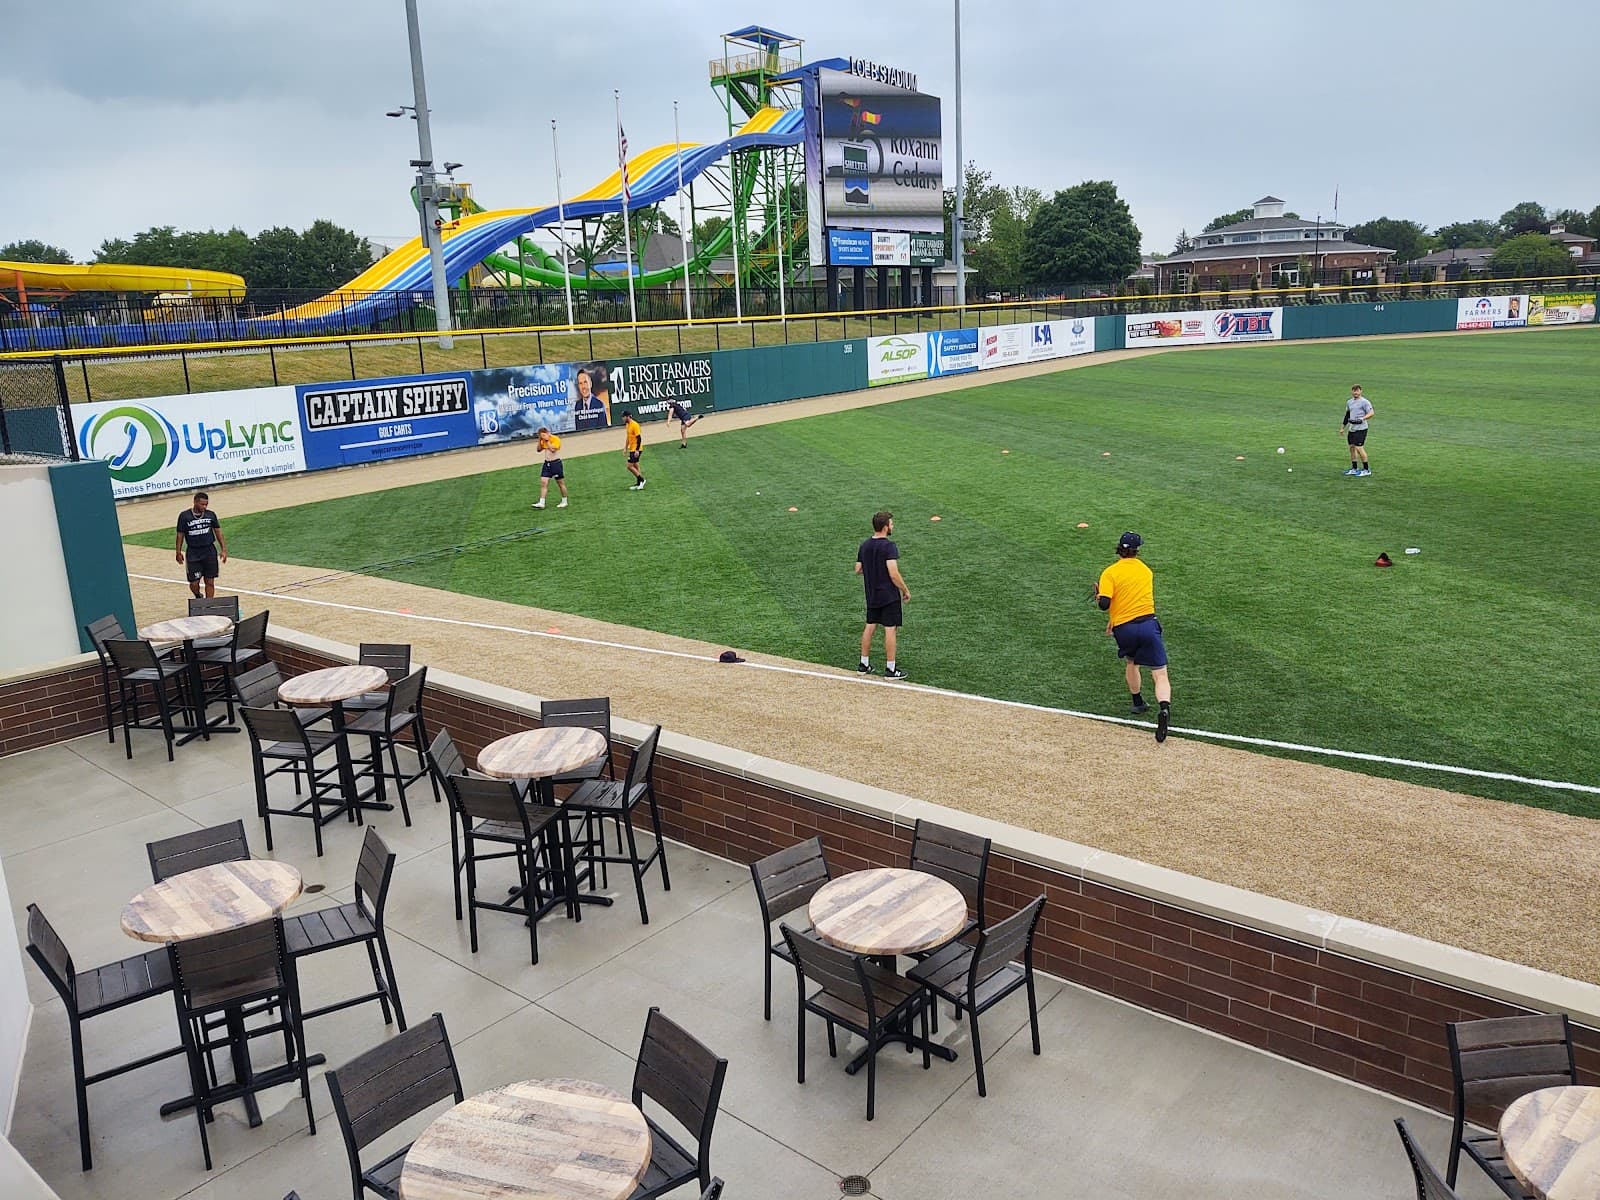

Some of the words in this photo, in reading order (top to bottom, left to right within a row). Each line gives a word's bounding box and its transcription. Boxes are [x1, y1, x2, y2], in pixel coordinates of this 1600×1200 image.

[849, 56, 878, 80] LOEB
[878, 64, 919, 92] STADIUM
[890, 137, 938, 161] Roxann
[893, 160, 937, 190] Cedars
[1235, 316, 1270, 331] TBT
[1464, 308, 1502, 316] FARMERS
[881, 348, 917, 362] ALSOP
[959, 342, 977, 351] SERVICES
[628, 363, 660, 383] FIRST
[661, 359, 711, 380] FARMERS
[507, 383, 553, 398] Precision
[555, 380, 567, 394] 18
[629, 382, 665, 402] BANK
[665, 380, 677, 397] &
[676, 376, 711, 396] TRUST
[309, 389, 398, 426] CAPTAIN
[403, 382, 465, 415] SPIFFY
[537, 400, 554, 408] Where
[554, 399, 565, 407] You
[378, 425, 393, 438] GOLF
[393, 423, 412, 437] CARTS
[480, 411, 498, 434] 18
[182, 419, 294, 462] UpLync
[215, 442, 296, 461] Communications
[113, 485, 144, 496] usiness
[145, 480, 171, 492] Phone
[172, 476, 210, 488] Company.
[213, 470, 237, 482] Trying
[237, 469, 246, 477] to
[246, 466, 263, 477] keep
[264, 464, 270, 473] it
[271, 461, 296, 473] simple!
